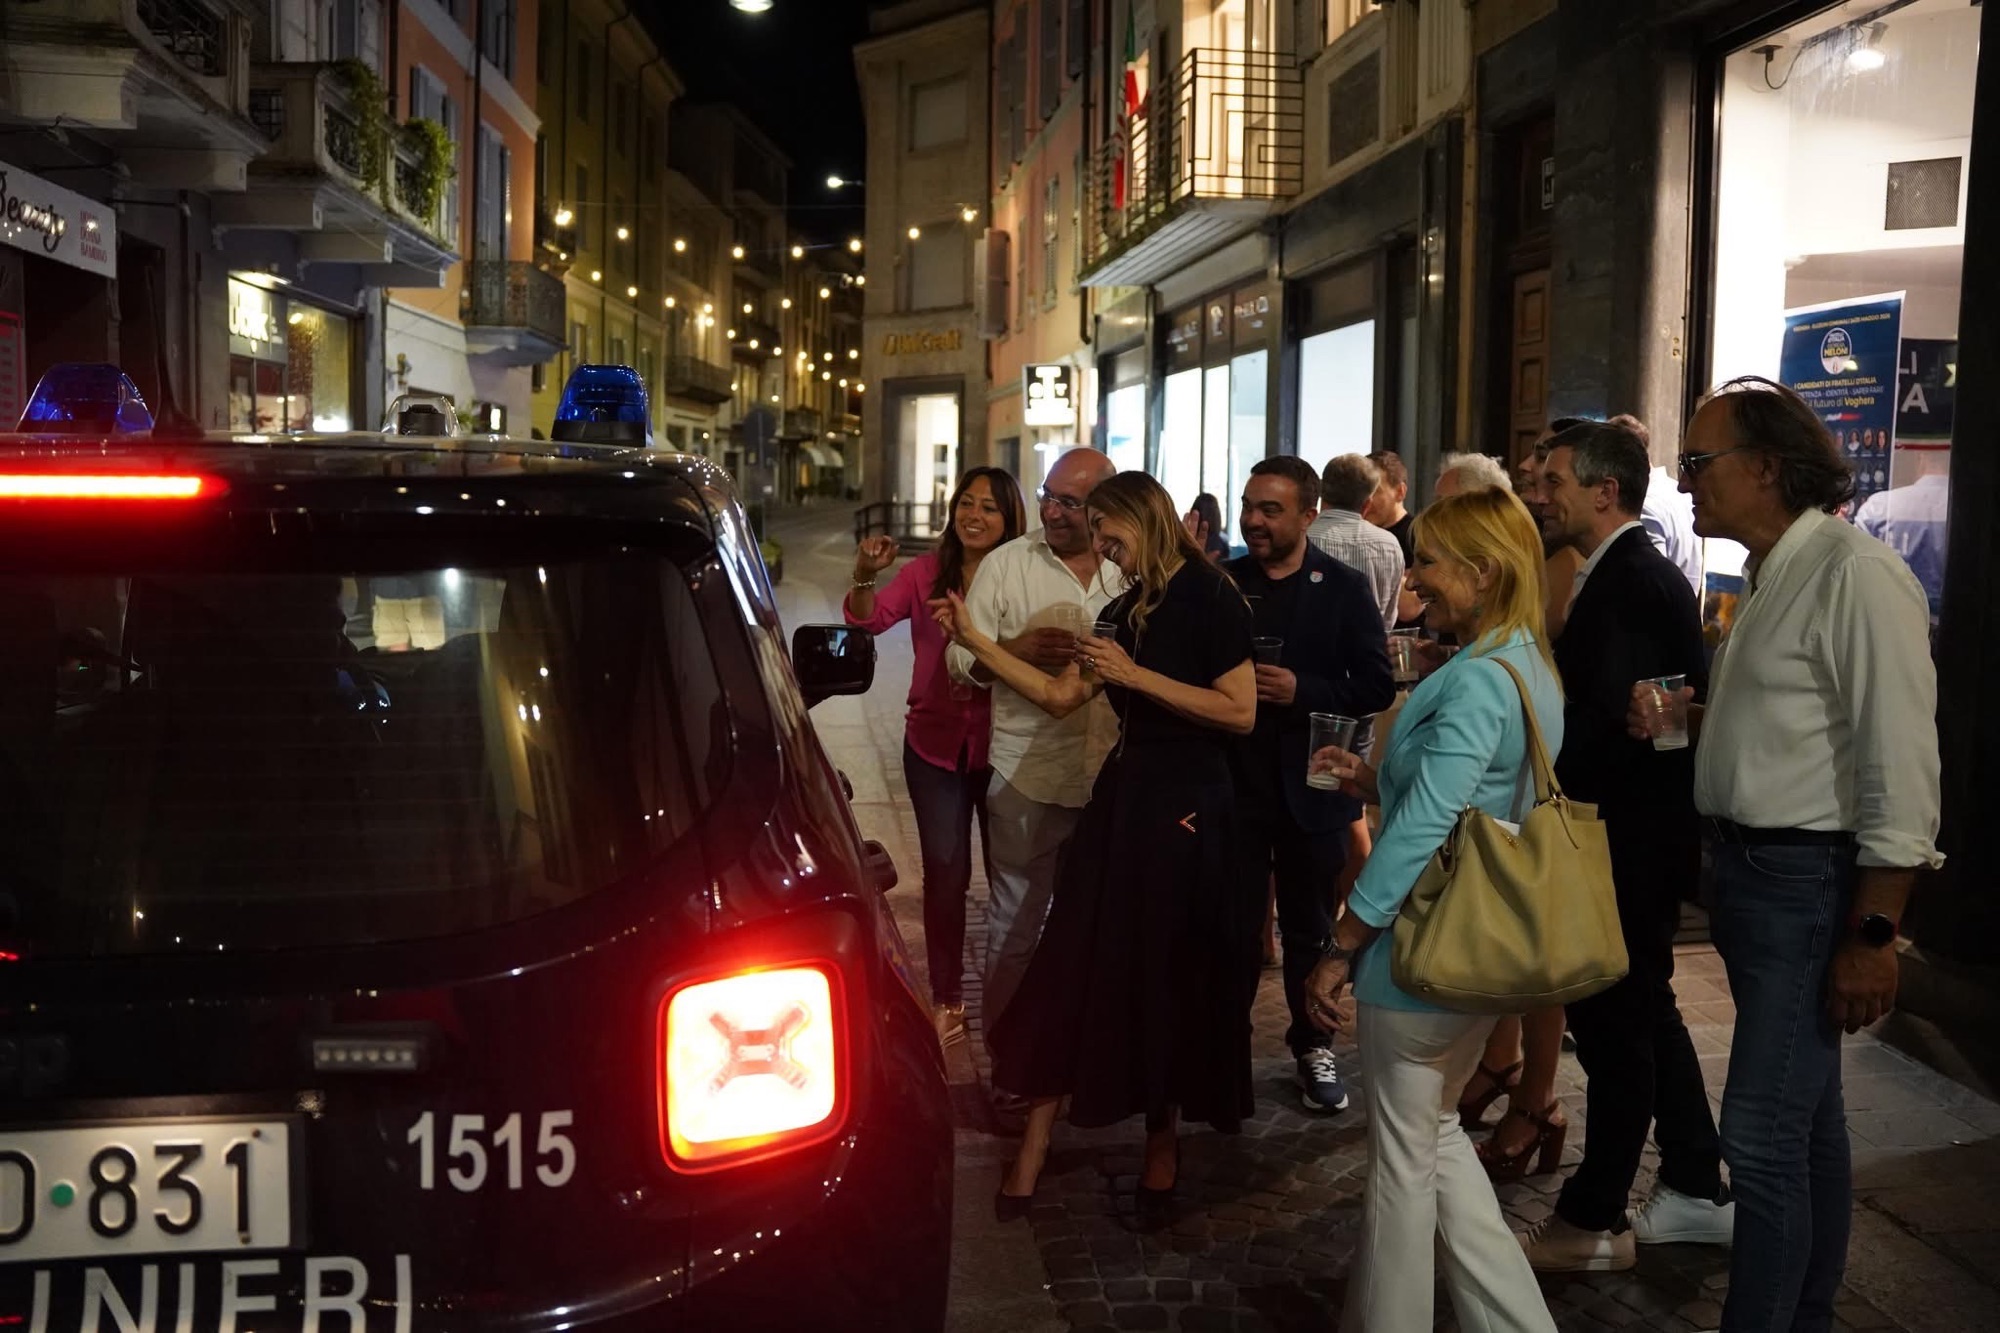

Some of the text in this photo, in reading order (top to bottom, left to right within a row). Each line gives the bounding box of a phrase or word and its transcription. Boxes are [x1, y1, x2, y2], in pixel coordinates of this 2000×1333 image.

[1844, 396, 1875, 408] Voghera
[90, 1142, 249, 1238] 831
[407, 1108, 577, 1193] 1515
